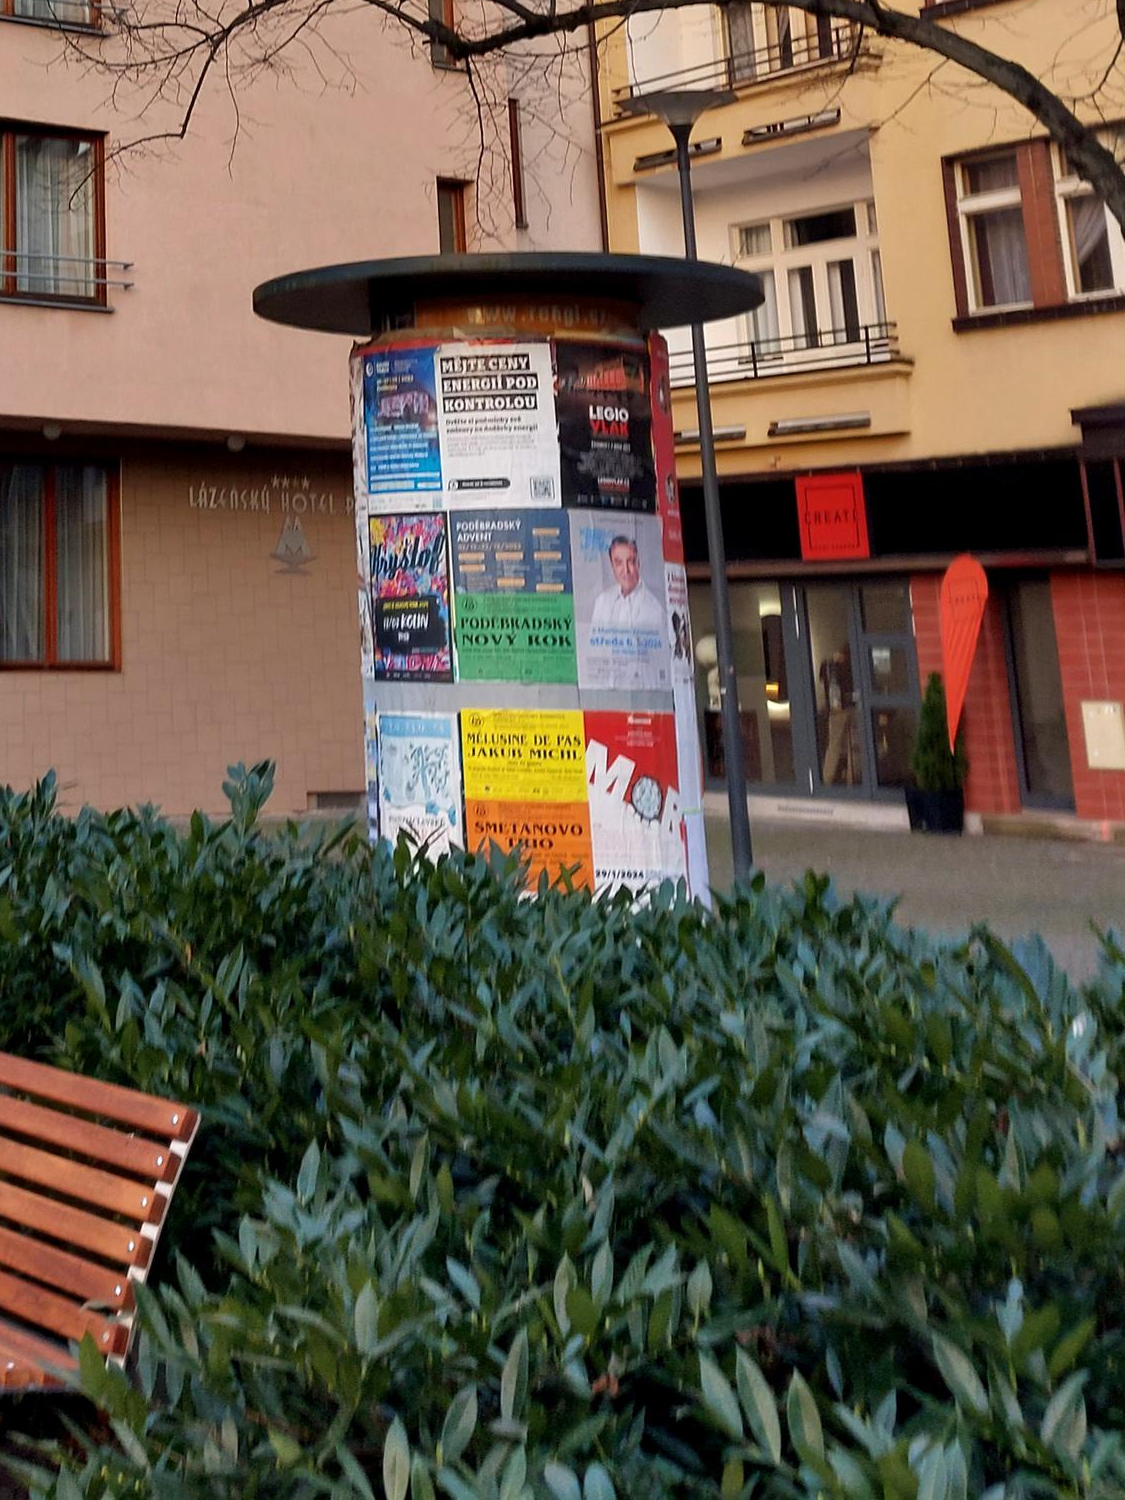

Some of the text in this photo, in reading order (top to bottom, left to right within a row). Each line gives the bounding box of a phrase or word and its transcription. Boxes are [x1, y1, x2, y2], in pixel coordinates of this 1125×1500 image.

[441, 355, 529, 374] MĚJTE CENY
[443, 373, 537, 392] ENERGIÍ POD
[444, 396, 536, 412] KONTROLOU
[589, 404, 629, 422] LEGIO
[590, 420, 630, 437] VLAK
[281, 493, 337, 516] HOTEL
[456, 517, 522, 532] PODĚBRADSKÝ
[804, 509, 859, 525] CREATE
[457, 531, 493, 543] ADVENT
[460, 614, 572, 631] PODĚBRADSKÝ
[462, 630, 572, 647] NOVÝ ROK
[466, 730, 581, 747] MÉLUSINE DE PAS
[467, 747, 582, 761] JAKUB MICHL
[474, 821, 584, 836] SMETANOVO
